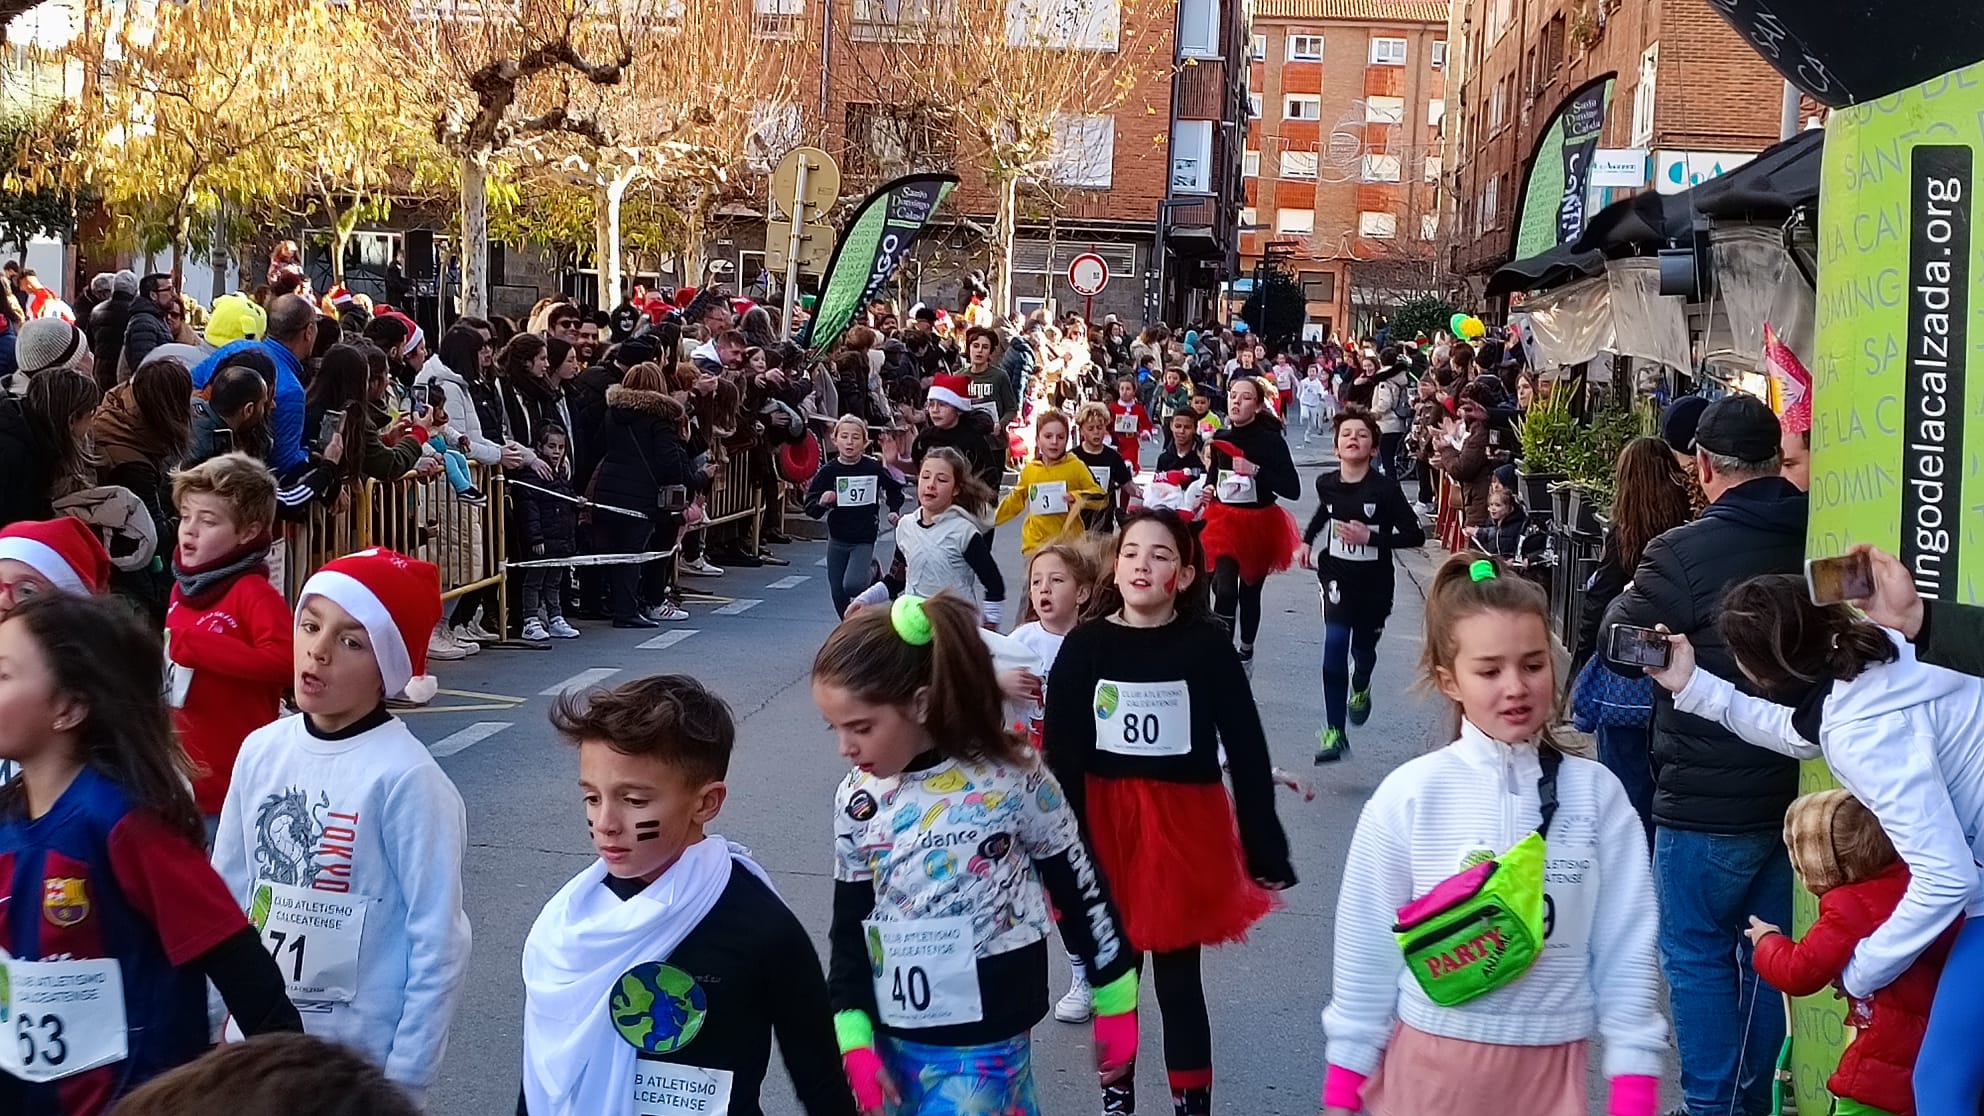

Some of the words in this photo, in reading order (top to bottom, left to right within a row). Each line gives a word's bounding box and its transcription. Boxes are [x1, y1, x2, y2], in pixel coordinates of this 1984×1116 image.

[850, 488, 866, 502] 97
[1042, 495, 1050, 509] 3
[1123, 712, 1160, 745] 80
[311, 811, 360, 893] TOKYO
[920, 829, 978, 849] dance
[269, 929, 308, 983] 71
[1424, 927, 1506, 980] PARTY
[892, 965, 932, 1012] 40
[16, 1012, 67, 1066] 63
[646, 1075, 718, 1097] ATLETISMO
